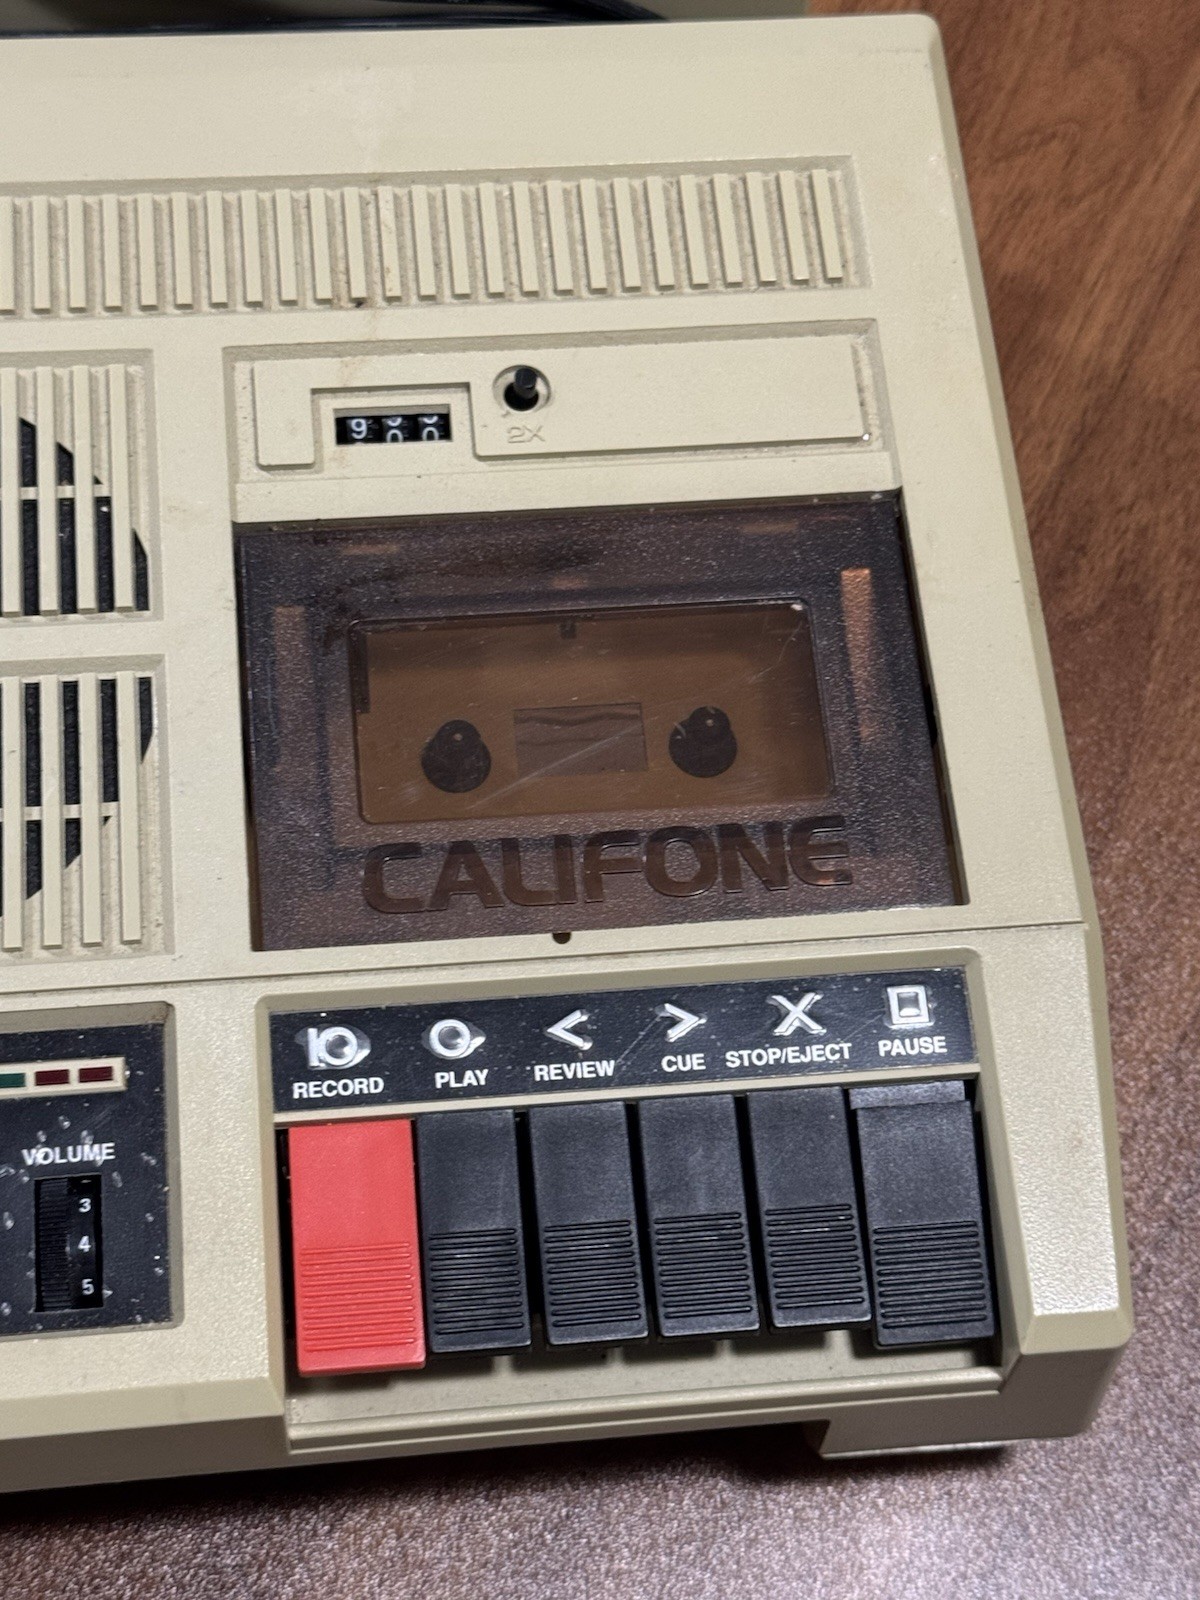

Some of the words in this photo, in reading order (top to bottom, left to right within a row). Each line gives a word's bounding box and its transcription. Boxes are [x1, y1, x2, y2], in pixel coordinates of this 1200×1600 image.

[507, 424, 546, 444] 2X
[361, 814, 853, 915] CALIFONE
[725, 1042, 852, 1069] STOP/EJECT
[877, 1036, 948, 1058] PAUSE
[534, 1059, 616, 1082] REVIEW
[661, 1053, 707, 1073] CUE
[292, 1076, 385, 1100] RECORD
[434, 1068, 489, 1089] PLAY
[21, 1142, 116, 1166] VOLUME
[78, 1197, 92, 1214] 3
[77, 1235, 92, 1253] 4
[81, 1278, 95, 1296] 5
